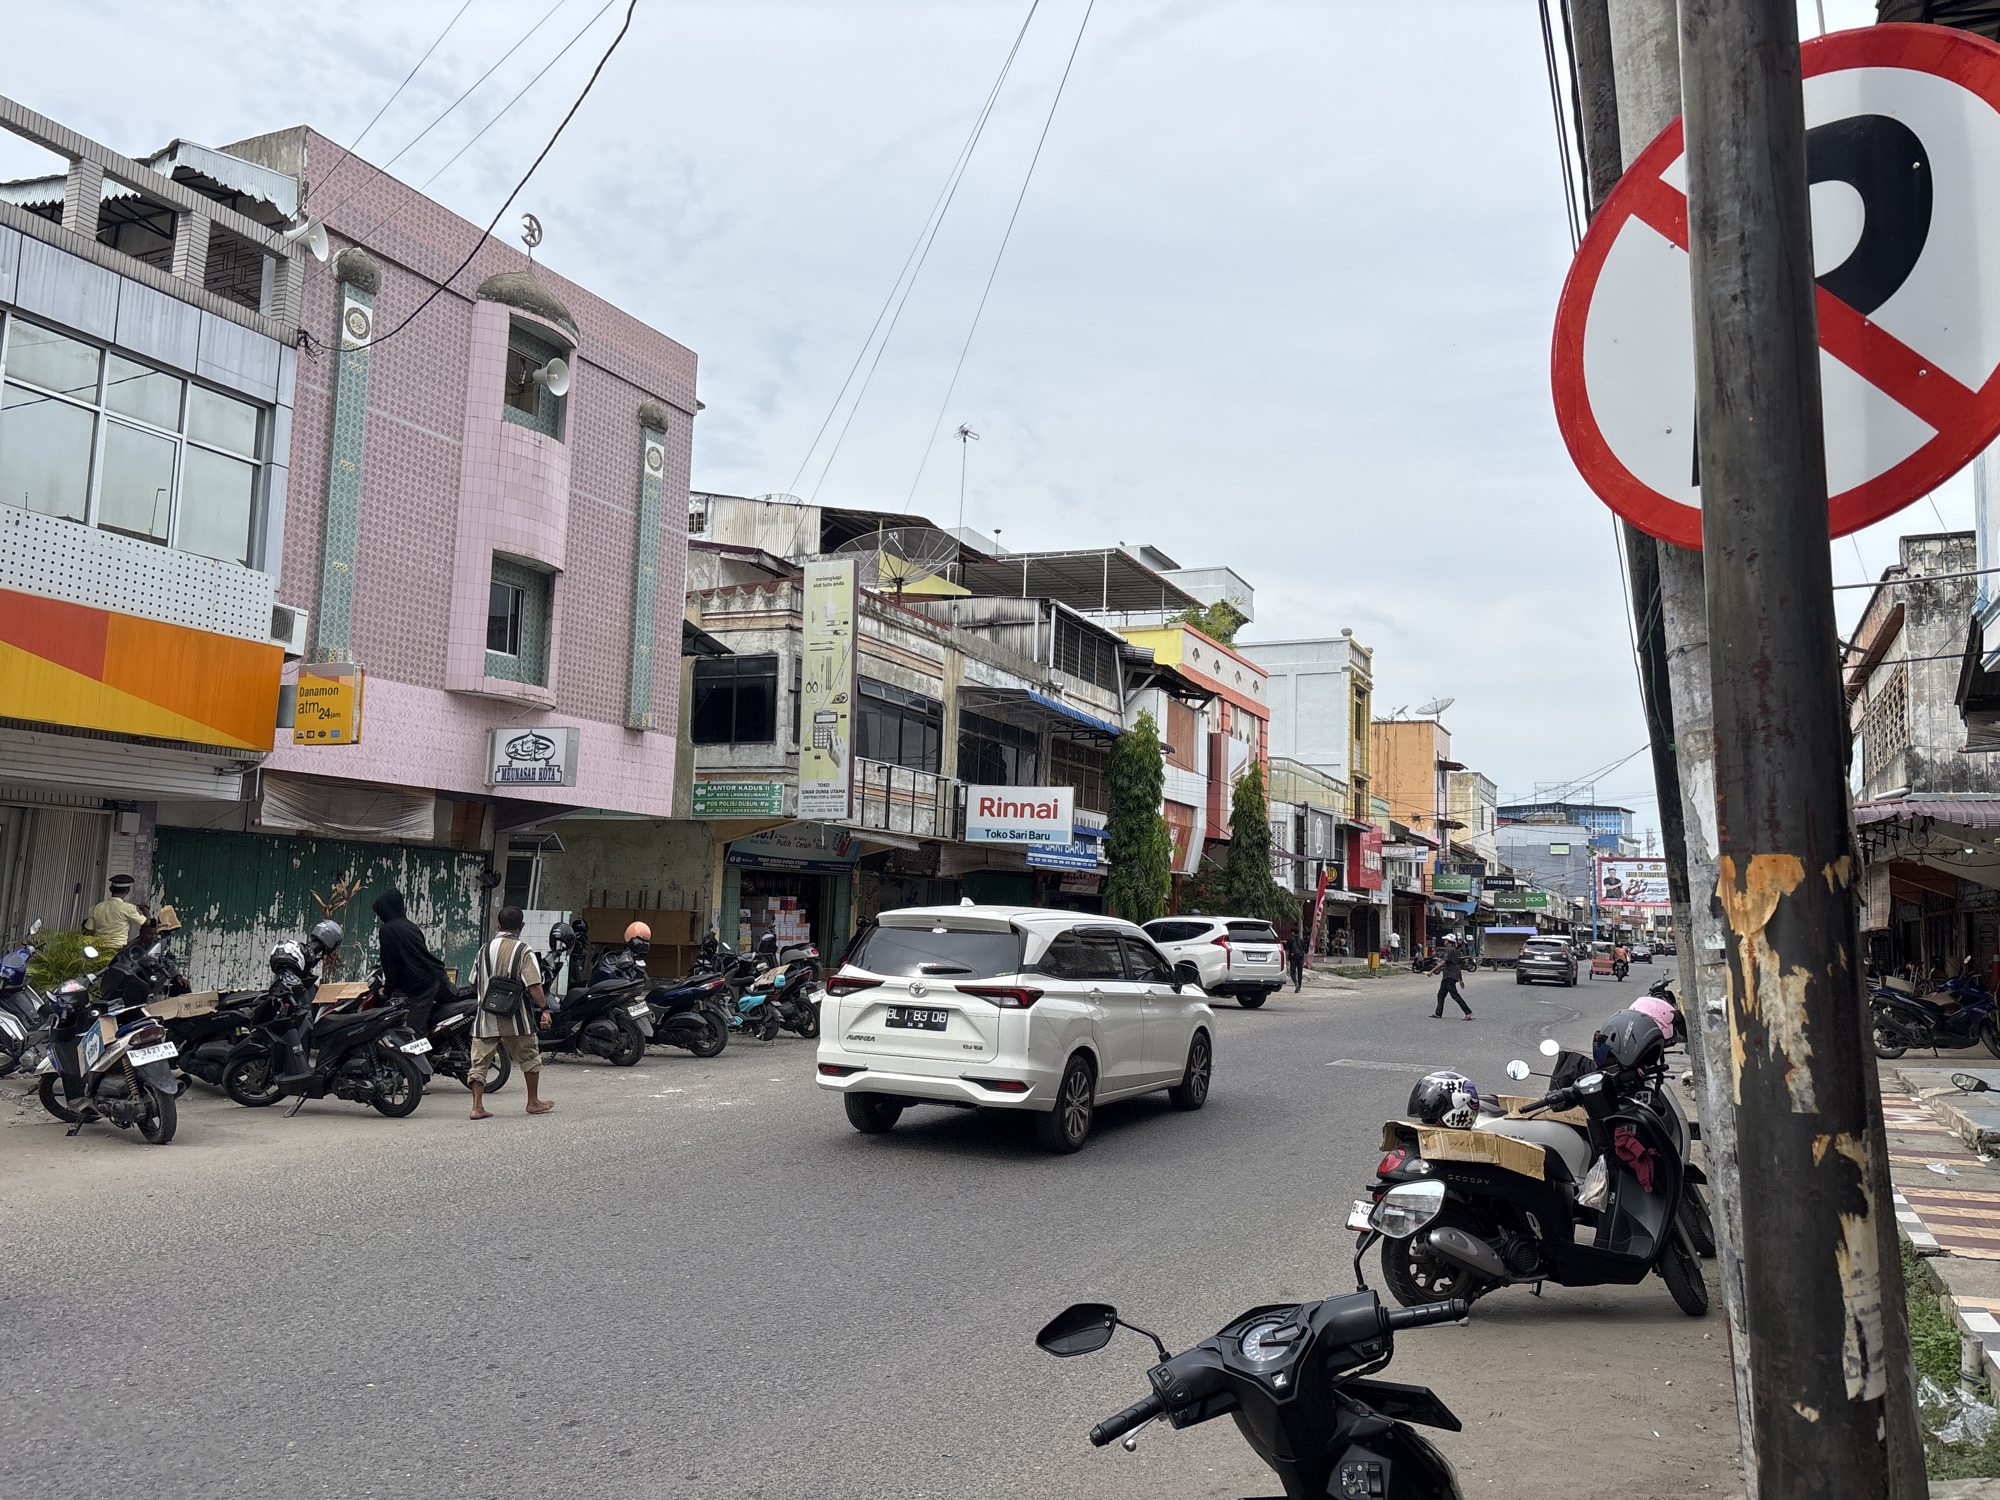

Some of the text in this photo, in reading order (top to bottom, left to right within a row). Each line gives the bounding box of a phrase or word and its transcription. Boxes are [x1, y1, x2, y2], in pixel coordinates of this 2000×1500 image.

[300, 686, 339, 698] Danamon
[298, 700, 341, 720] atm 24 jam
[501, 766, 556, 780] MEUNASAH KOTA
[979, 796, 1058, 819] Rinnai
[985, 829, 1050, 840] Toko Sari Baru
[1065, 840, 1085, 855] BARU
[887, 1008, 900, 1019] BL
[450, 1015, 475, 1030] HONDA
[142, 1047, 161, 1056] 3427
[1448, 1174, 1490, 1185] SCOOPY
[1352, 1203, 1359, 1213] BL
